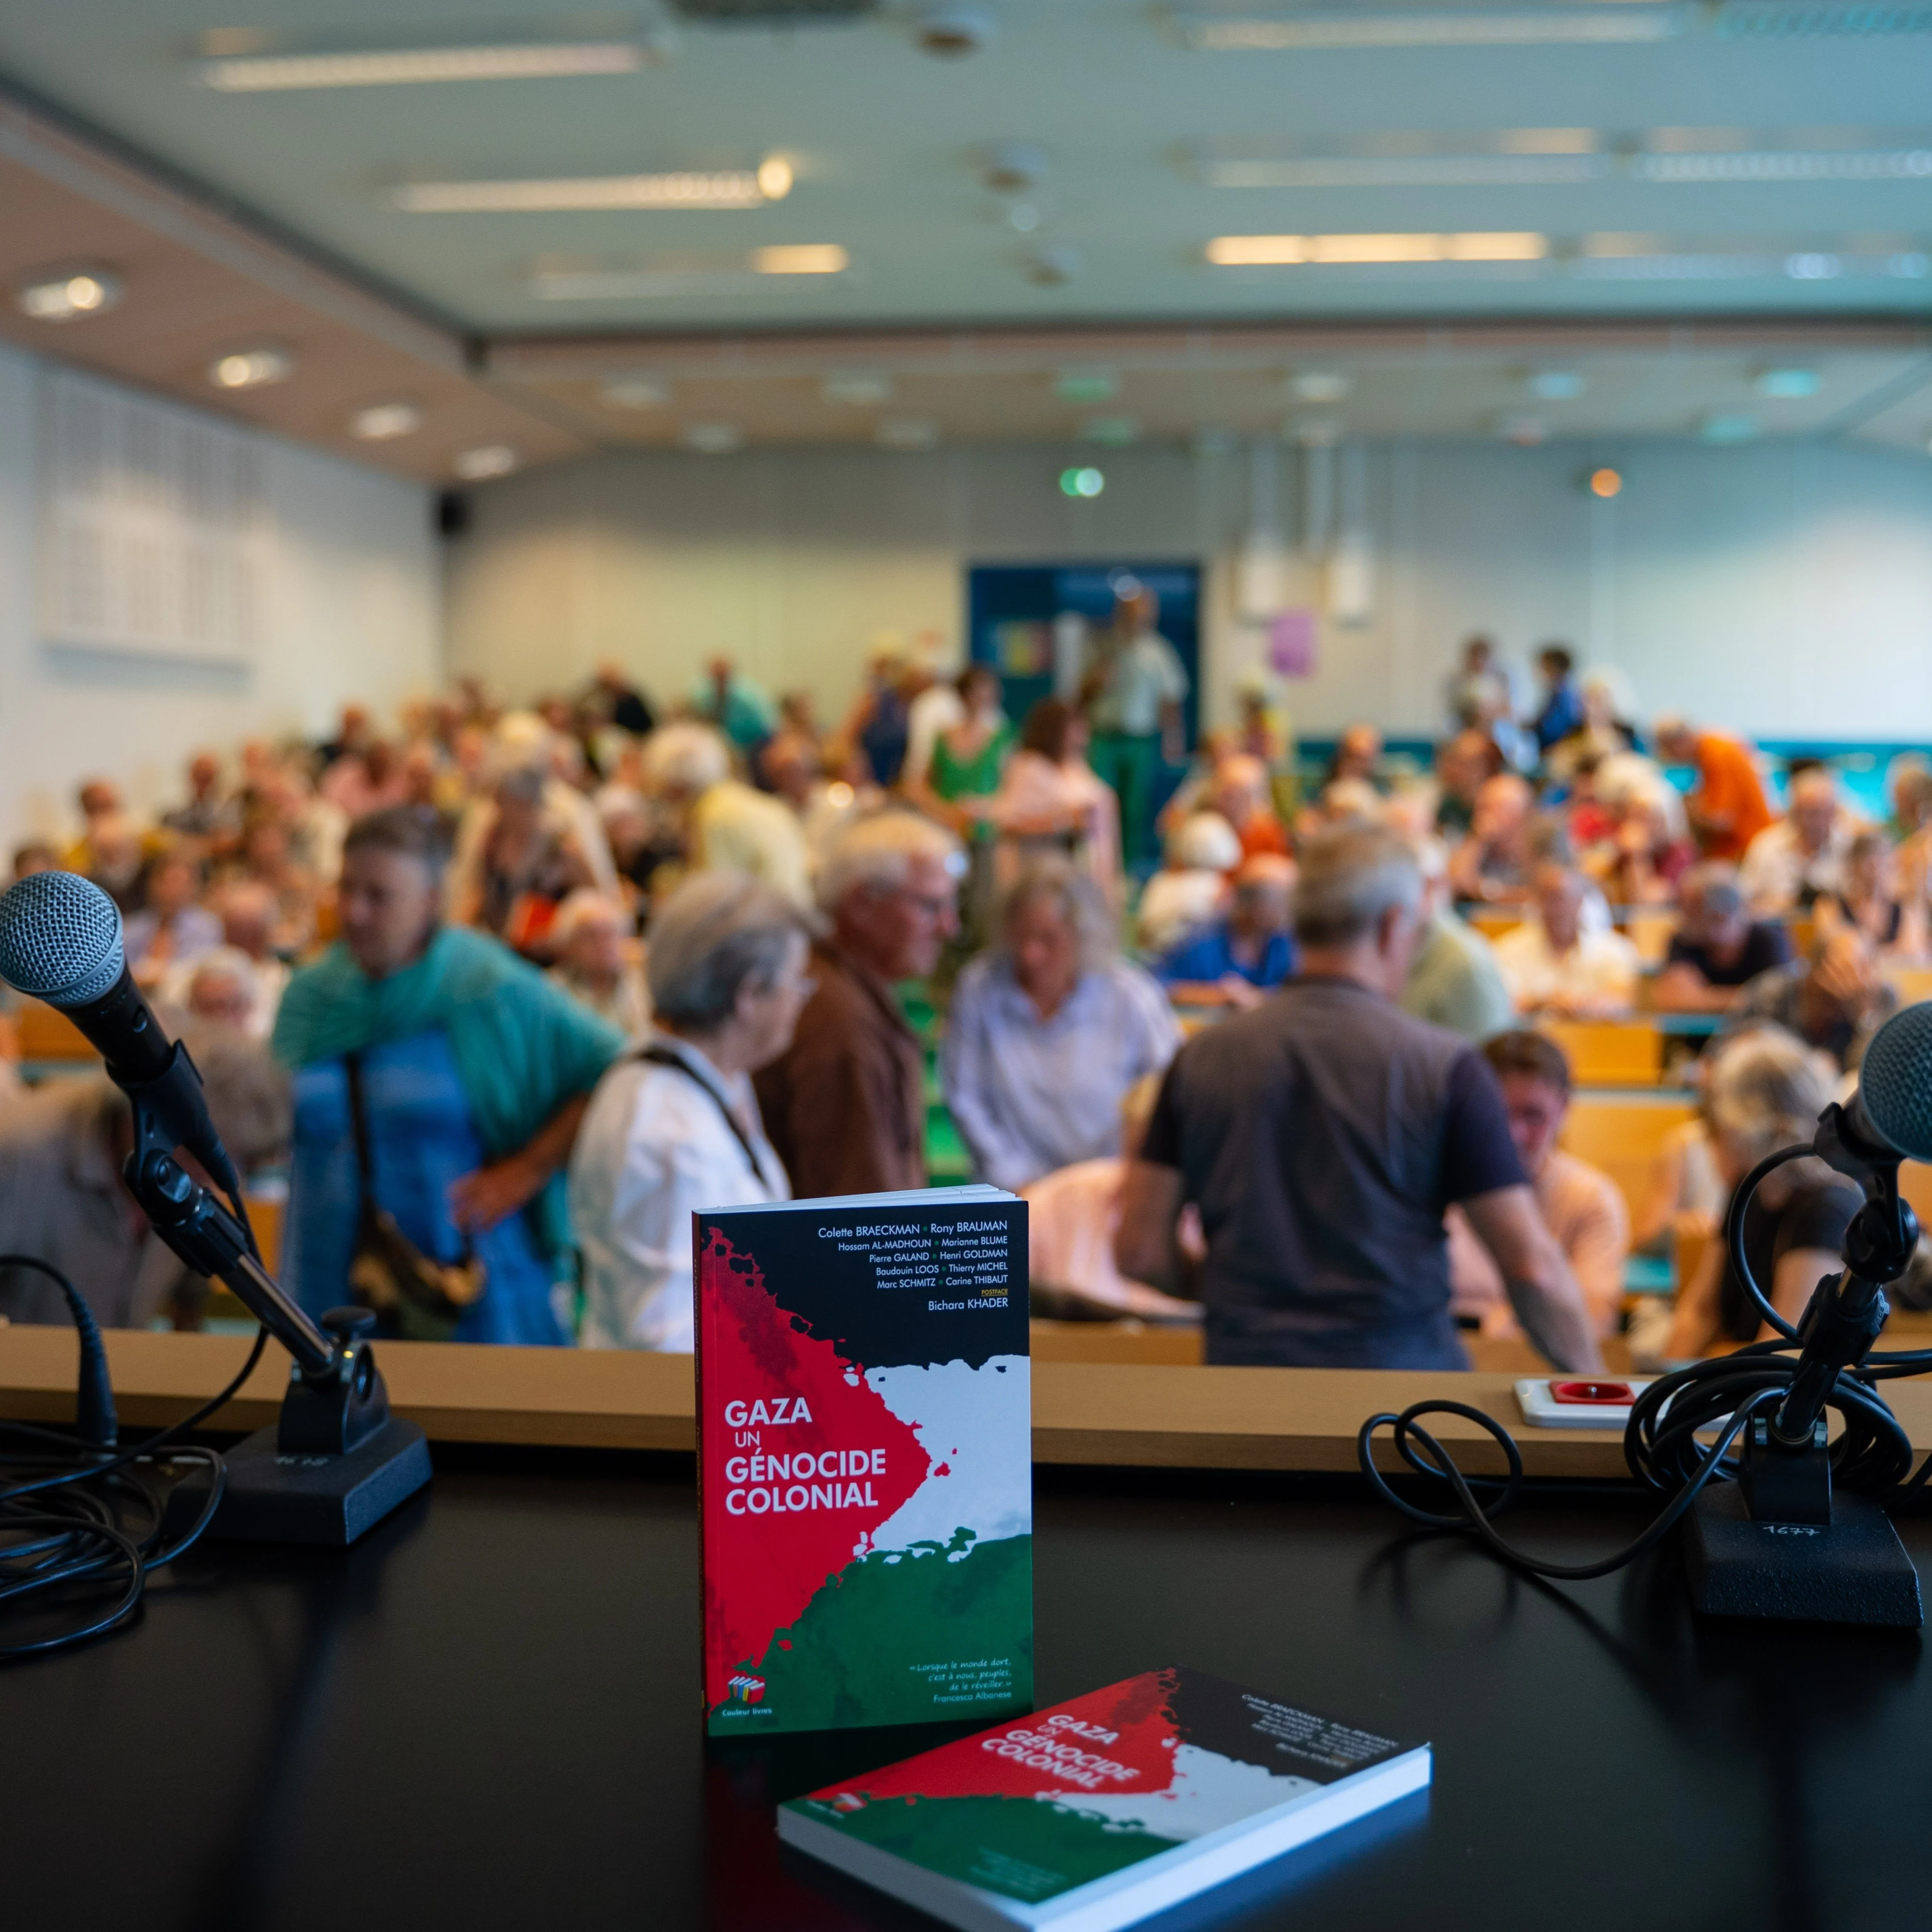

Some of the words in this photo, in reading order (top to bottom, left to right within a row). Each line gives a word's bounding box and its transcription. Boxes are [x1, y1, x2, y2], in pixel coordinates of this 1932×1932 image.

[818, 1227, 853, 1238] Colette
[856, 1224, 920, 1237] BRAECKMAN
[931, 1223, 954, 1235] Rony
[957, 1220, 1007, 1232] BRAUMAN
[838, 1242, 869, 1251] Hossam
[872, 1239, 931, 1249] AL-MADHOUN
[942, 1237, 978, 1246] Marianne
[981, 1236, 1007, 1245] BLUME
[869, 1254, 891, 1263] Pierre
[894, 1252, 929, 1262] GALAND
[940, 1251, 961, 1260] Henri
[963, 1249, 1007, 1259] GOLDMAN
[876, 1266, 913, 1275] Baudouin
[916, 1265, 939, 1274] LOOS
[949, 1263, 975, 1273] Thierry
[977, 1262, 1007, 1271] MICHEL
[877, 1280, 897, 1289] Marc
[899, 1278, 935, 1288] SCHMITZ
[946, 1277, 972, 1285] Carine
[974, 1275, 1007, 1284] THIBAUT
[928, 1301, 964, 1311] Bichara
[968, 1298, 1008, 1309] KHADER
[725, 1397, 812, 1427] GAZA
[735, 1431, 760, 1447] UN
[725, 1448, 886, 1483] GÉNOCIDE
[726, 1482, 878, 1515] COLONIAL
[1763, 1526, 1820, 1536] 1677
[961, 1659, 987, 1668] monde
[934, 1692, 973, 1703] Francesca
[1048, 1714, 1120, 1744] GAZA
[982, 1739, 1105, 1788] COLONIAL
